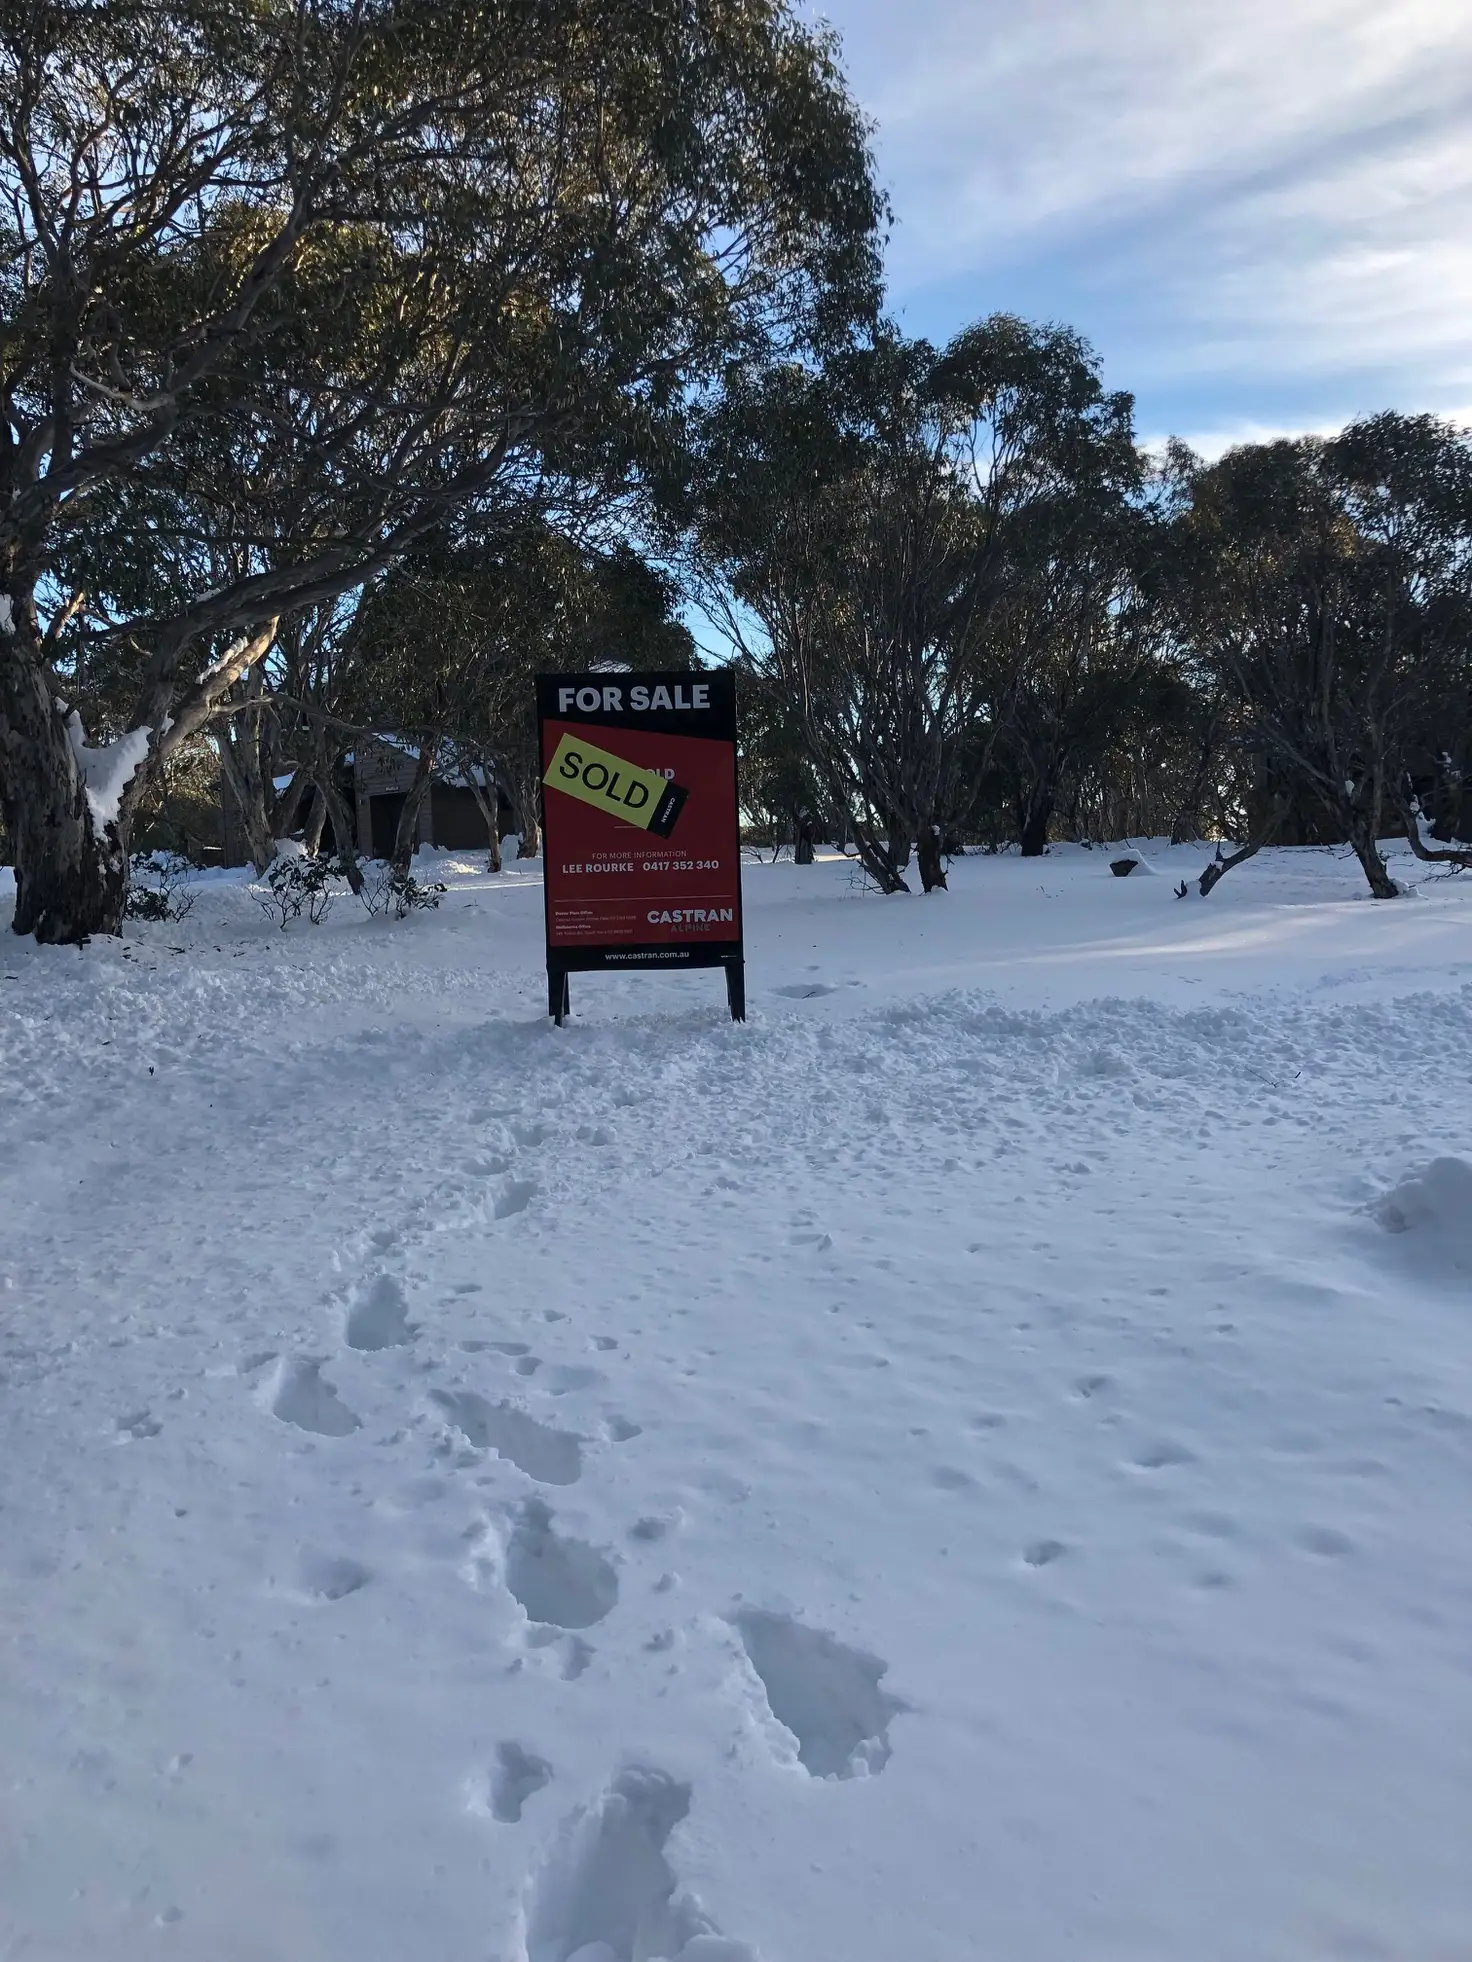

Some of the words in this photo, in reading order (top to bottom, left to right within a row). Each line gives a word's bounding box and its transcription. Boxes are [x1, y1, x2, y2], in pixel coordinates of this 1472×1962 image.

[558, 687, 623, 712] FOR
[630, 684, 711, 711] SALE
[559, 751, 650, 809] SOLD
[660, 797, 676, 824] CASTRAN
[592, 852, 608, 860] FOR
[609, 851, 632, 859] MORE
[633, 850, 687, 859] INFORMATION
[562, 864, 583, 874] LEE
[585, 862, 634, 873] ROURKE
[642, 861, 670, 871] 0417
[672, 860, 694, 870] 352
[696, 860, 719, 869] 340
[647, 908, 733, 924] CASTRAN
[671, 923, 711, 932] ALPINE
[605, 951, 690, 960] www.castran.com.au
